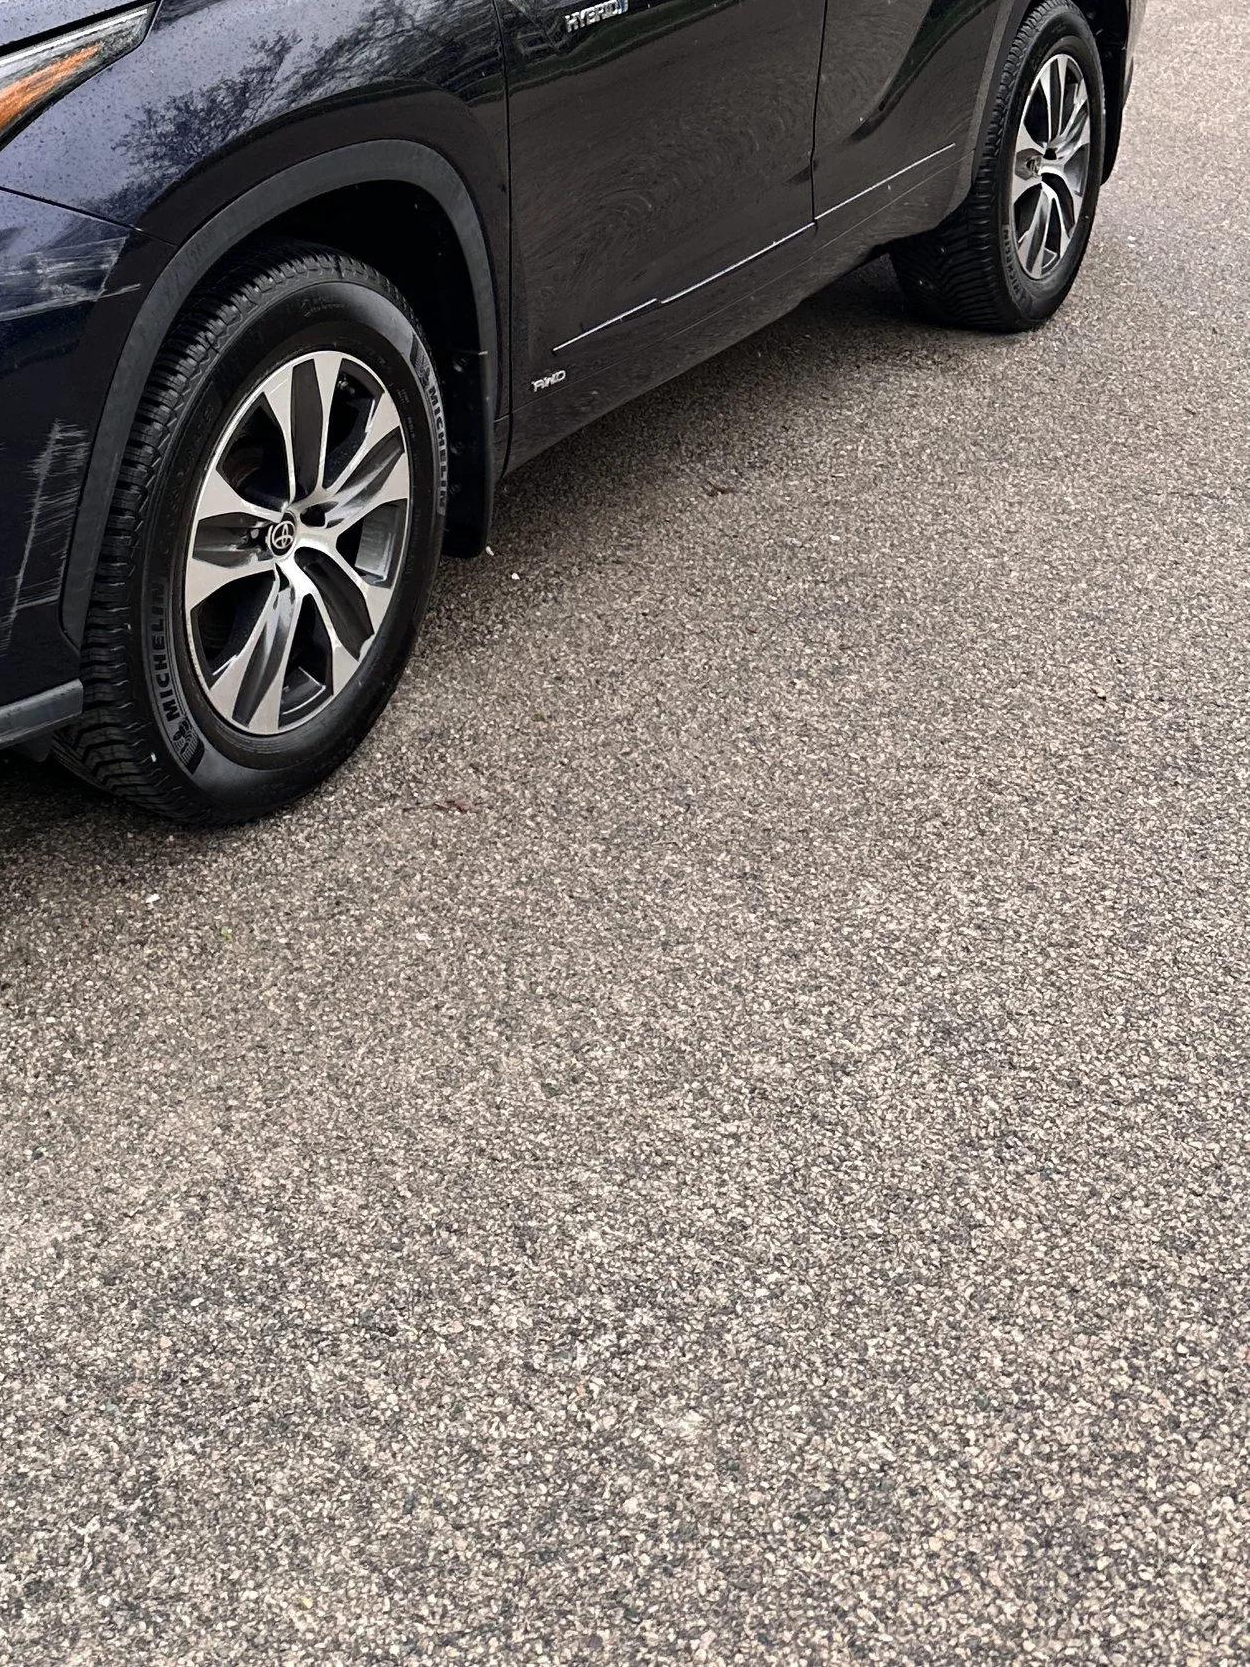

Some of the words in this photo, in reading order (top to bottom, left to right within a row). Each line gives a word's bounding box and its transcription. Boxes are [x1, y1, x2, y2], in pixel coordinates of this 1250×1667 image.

[565, 0, 619, 33] HYBRID
[531, 370, 566, 392] AWD
[428, 385, 448, 509] MICHELIN
[151, 582, 180, 722] MICHELIN
